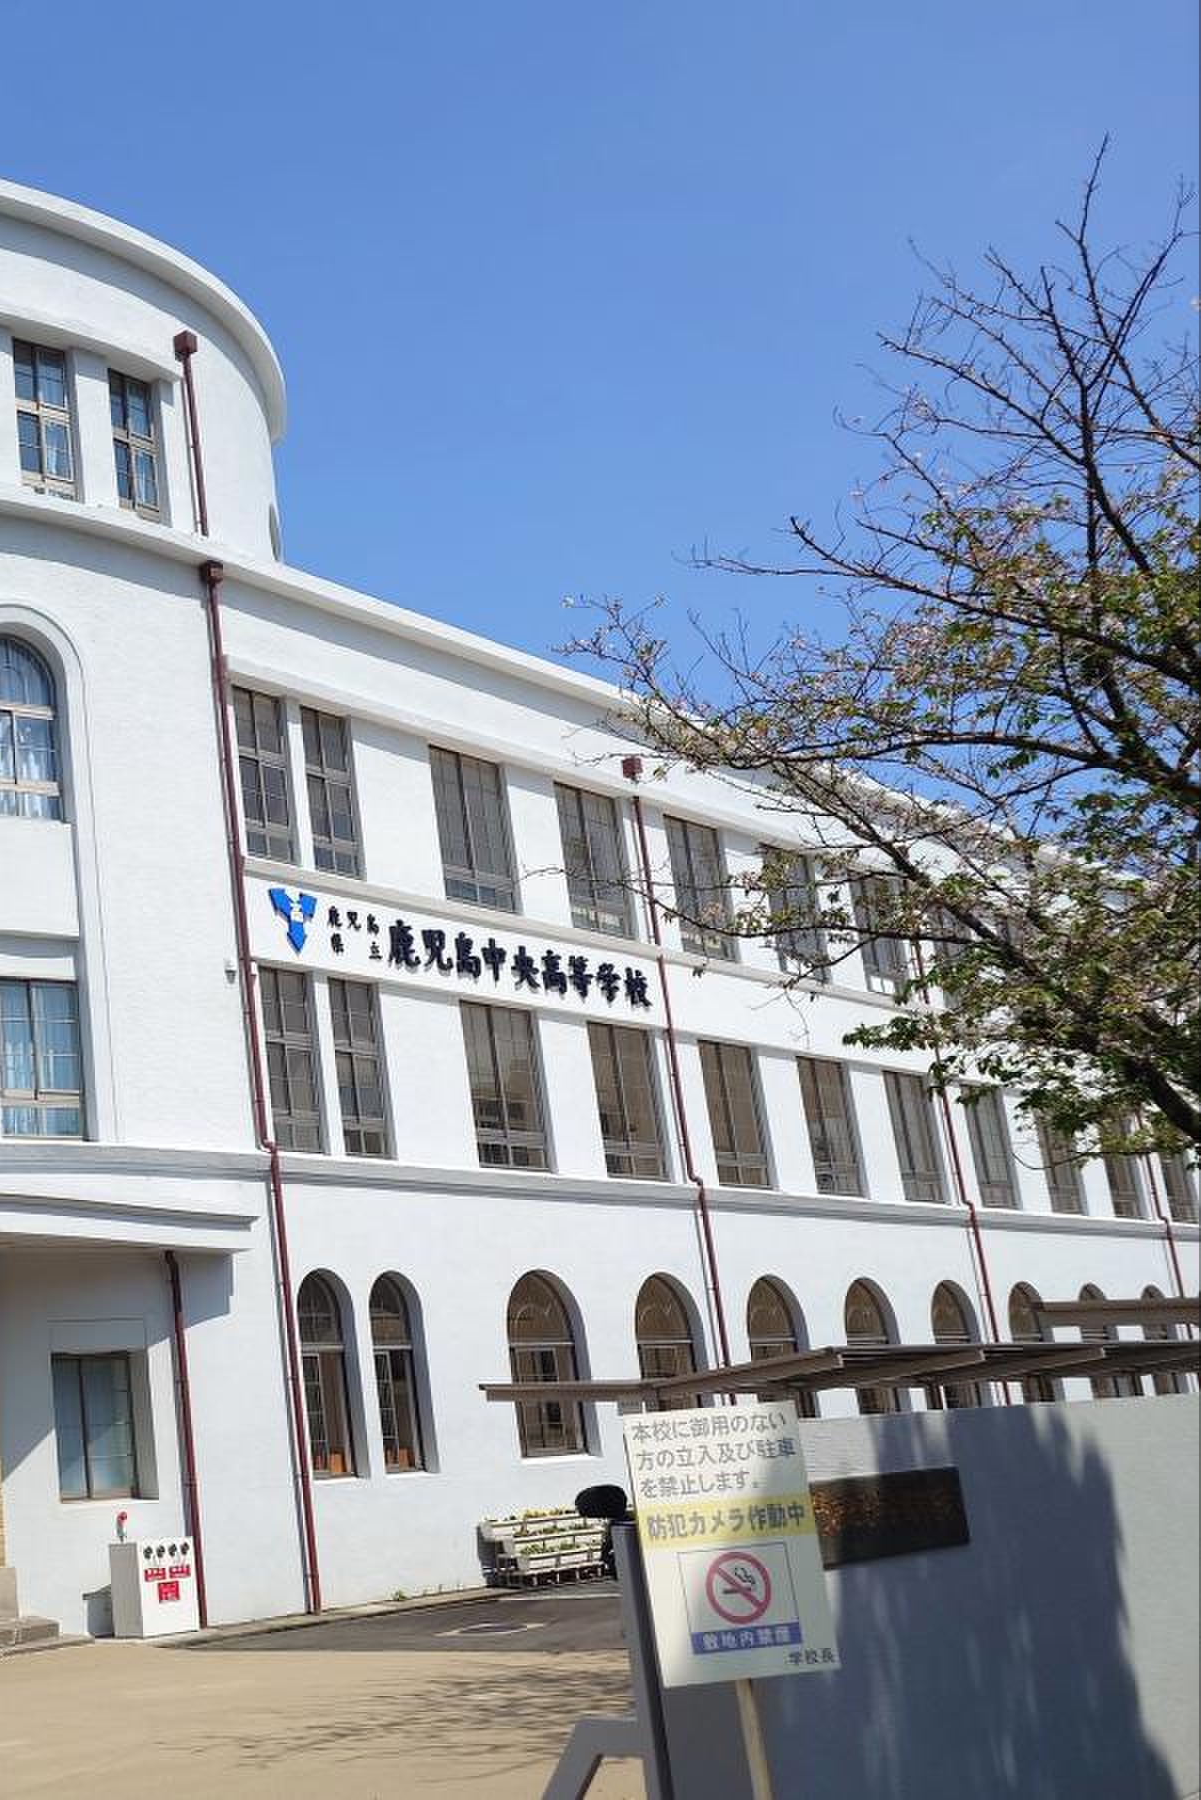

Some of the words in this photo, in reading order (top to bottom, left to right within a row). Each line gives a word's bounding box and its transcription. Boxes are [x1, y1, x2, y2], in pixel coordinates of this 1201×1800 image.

[327, 905, 380, 935] 鹿児島
[387, 919, 653, 1008] 鹿児島中央高等学校
[631, 1412, 787, 1441] 本校に御用のない
[636, 1437, 797, 1471] 方の立入及び駐車
[647, 1503, 806, 1540] 防犯カメラ作動中
